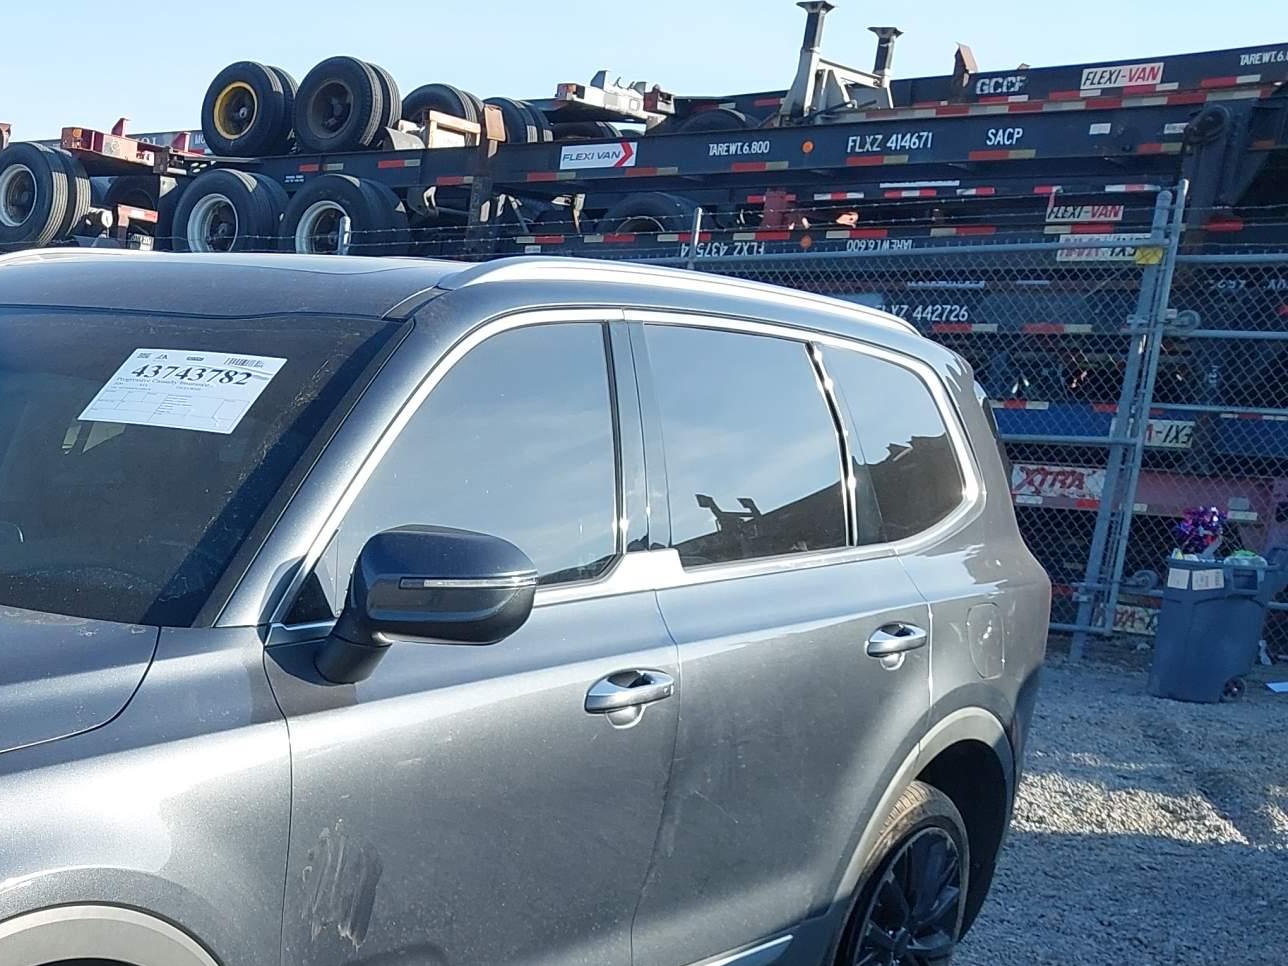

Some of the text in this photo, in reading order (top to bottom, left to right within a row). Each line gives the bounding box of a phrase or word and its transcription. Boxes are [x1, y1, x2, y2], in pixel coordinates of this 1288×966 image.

[1083, 65, 1161, 86] FLEXI-VAN
[847, 132, 933, 153] FLXZ 414671
[986, 128, 1023, 145] SACP
[562, 150, 621, 162] FLEXI VAN
[681, 241, 729, 258] 43754
[912, 304, 969, 321] 442726
[132, 364, 252, 385] 43743782
